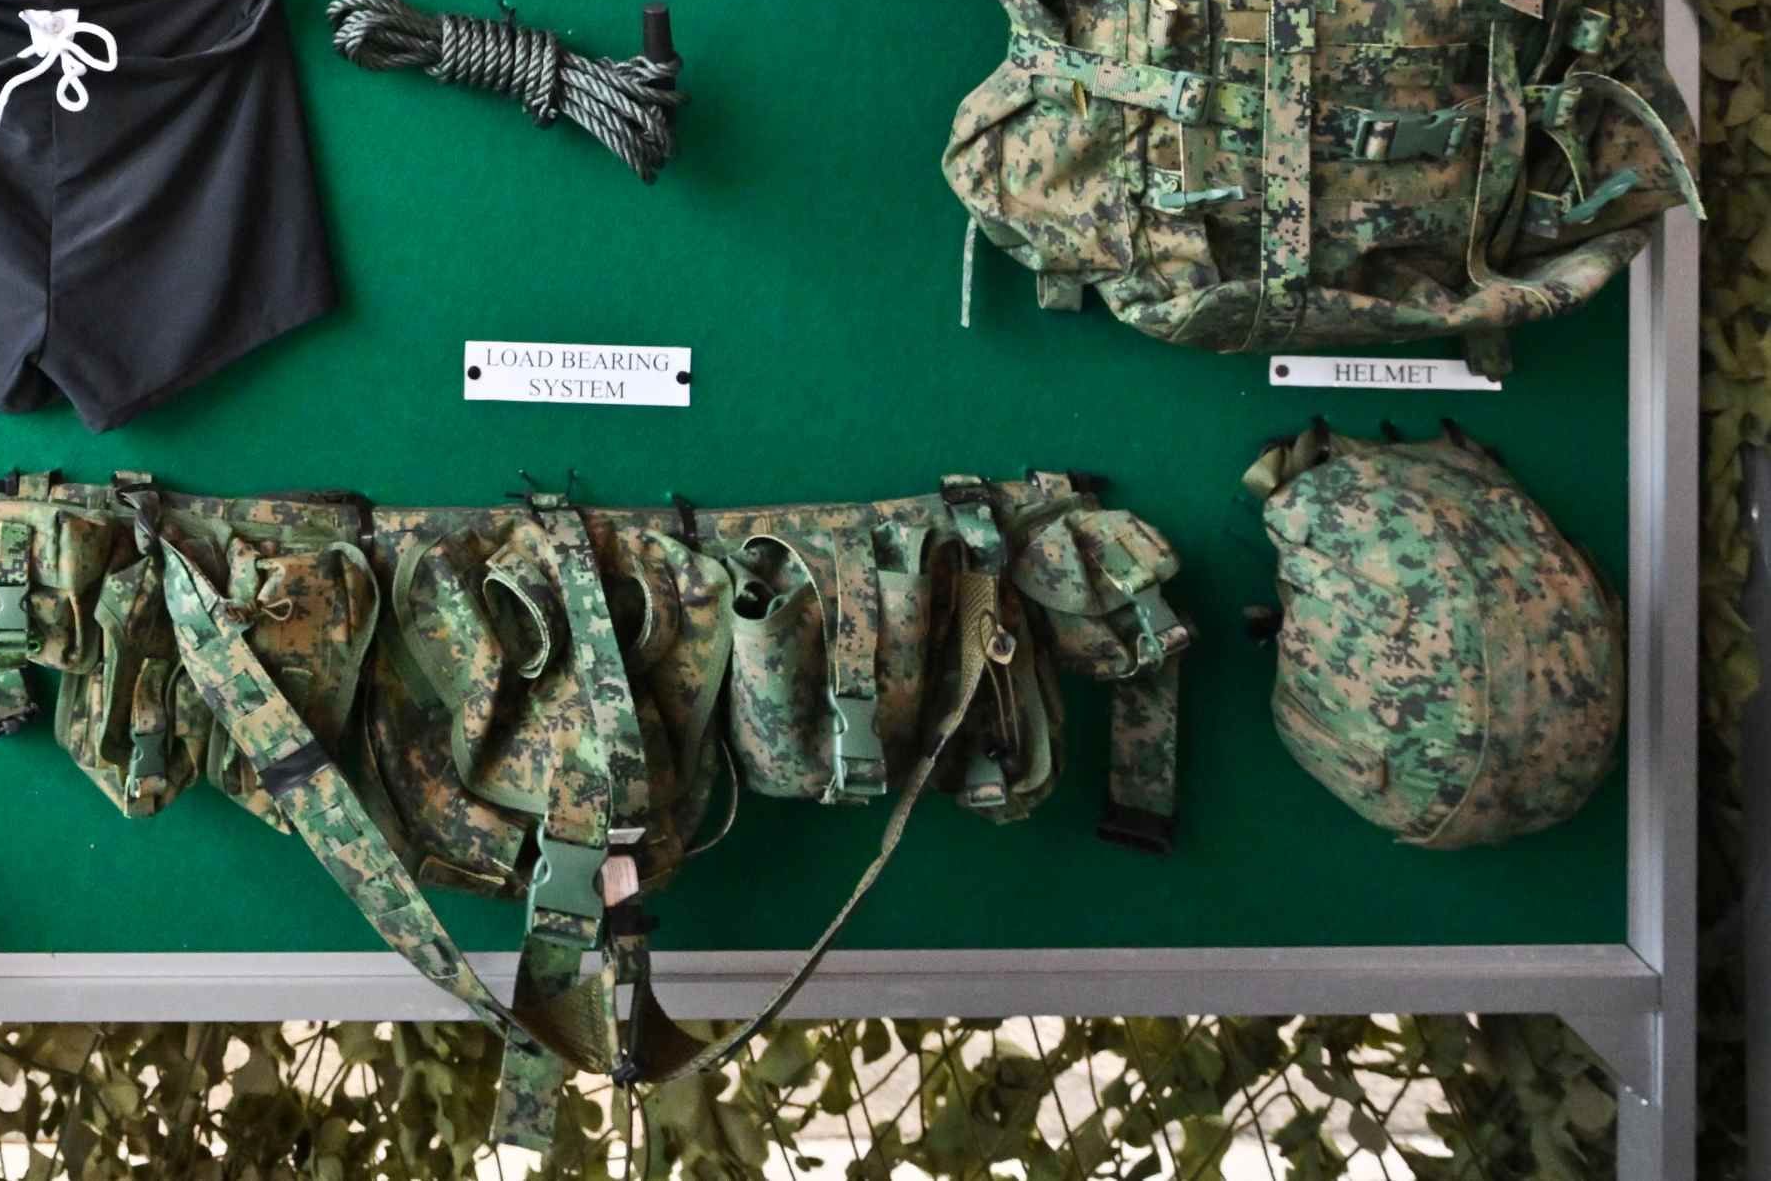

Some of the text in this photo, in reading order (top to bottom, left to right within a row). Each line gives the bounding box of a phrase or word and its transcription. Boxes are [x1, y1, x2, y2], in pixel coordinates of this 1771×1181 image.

[485, 347, 670, 372] LOAD BEARING
[1333, 363, 1439, 384] HELMET
[528, 378, 625, 399] SYSTEM
